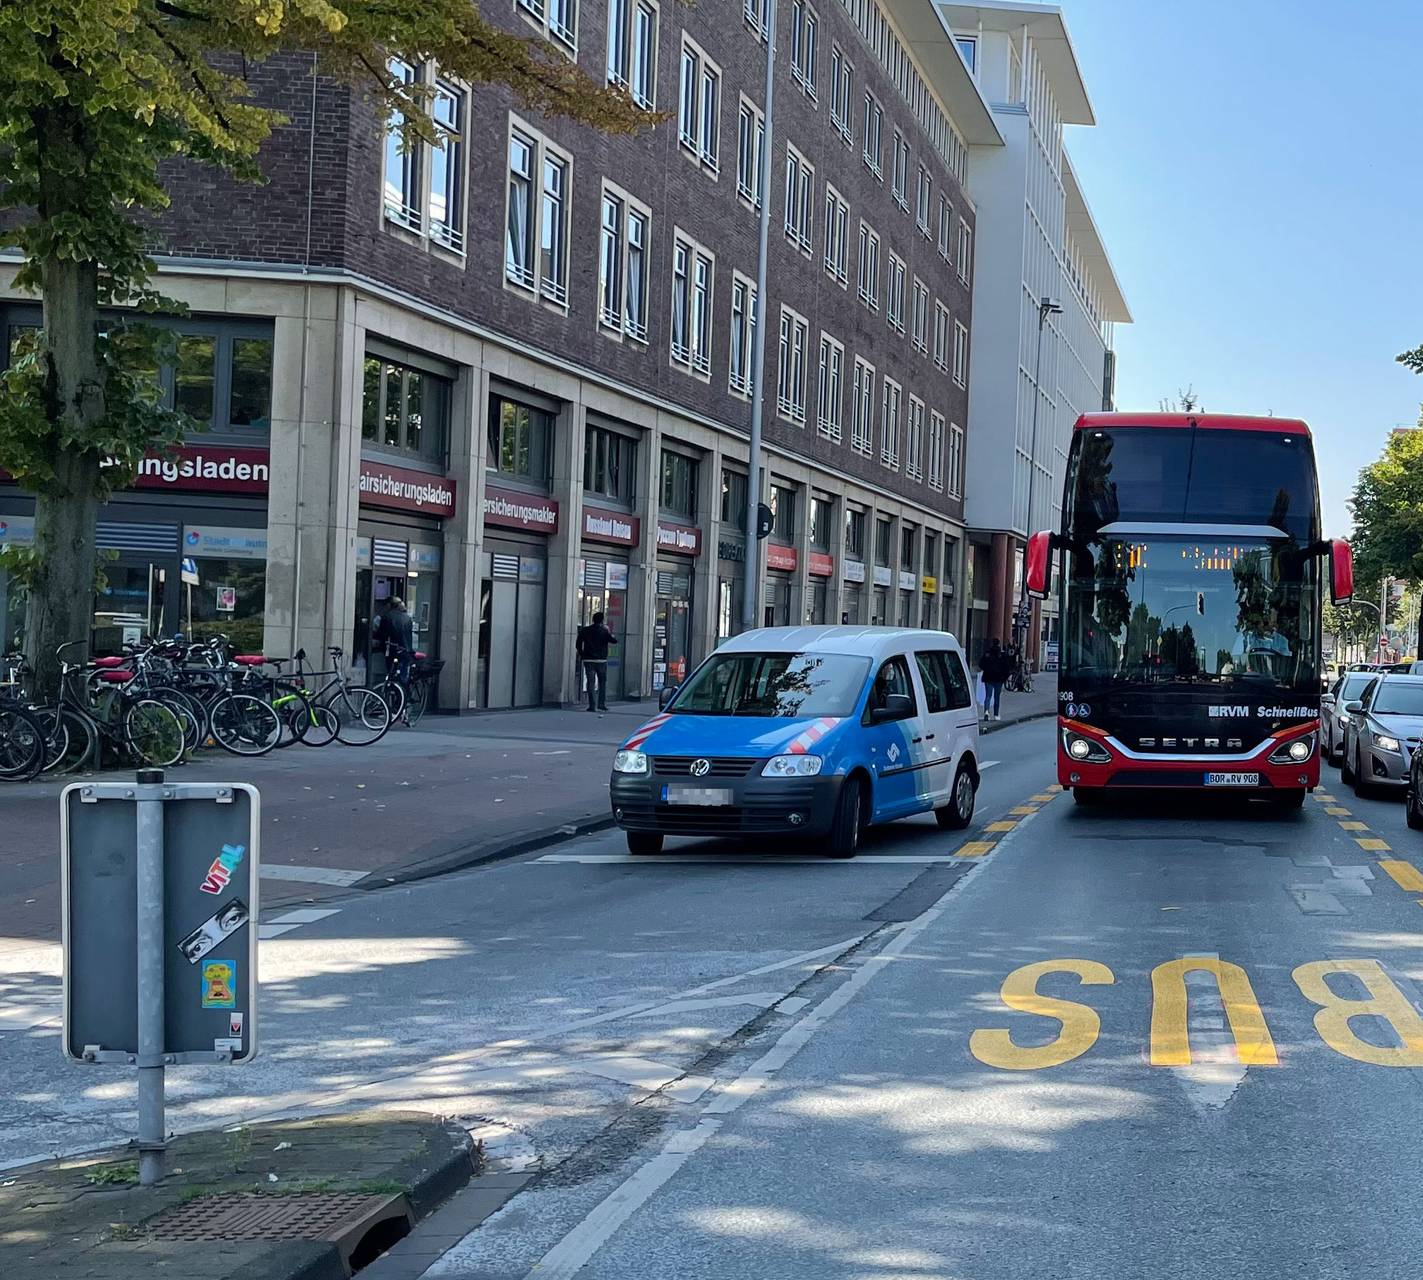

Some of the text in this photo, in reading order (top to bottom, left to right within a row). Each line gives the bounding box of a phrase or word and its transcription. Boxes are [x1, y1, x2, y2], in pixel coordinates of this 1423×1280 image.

[1219, 706, 1318, 718] RVM SchnellBus
[1138, 737, 1242, 748] SETRA
[1210, 774, 1258, 783] BOR RV 908
